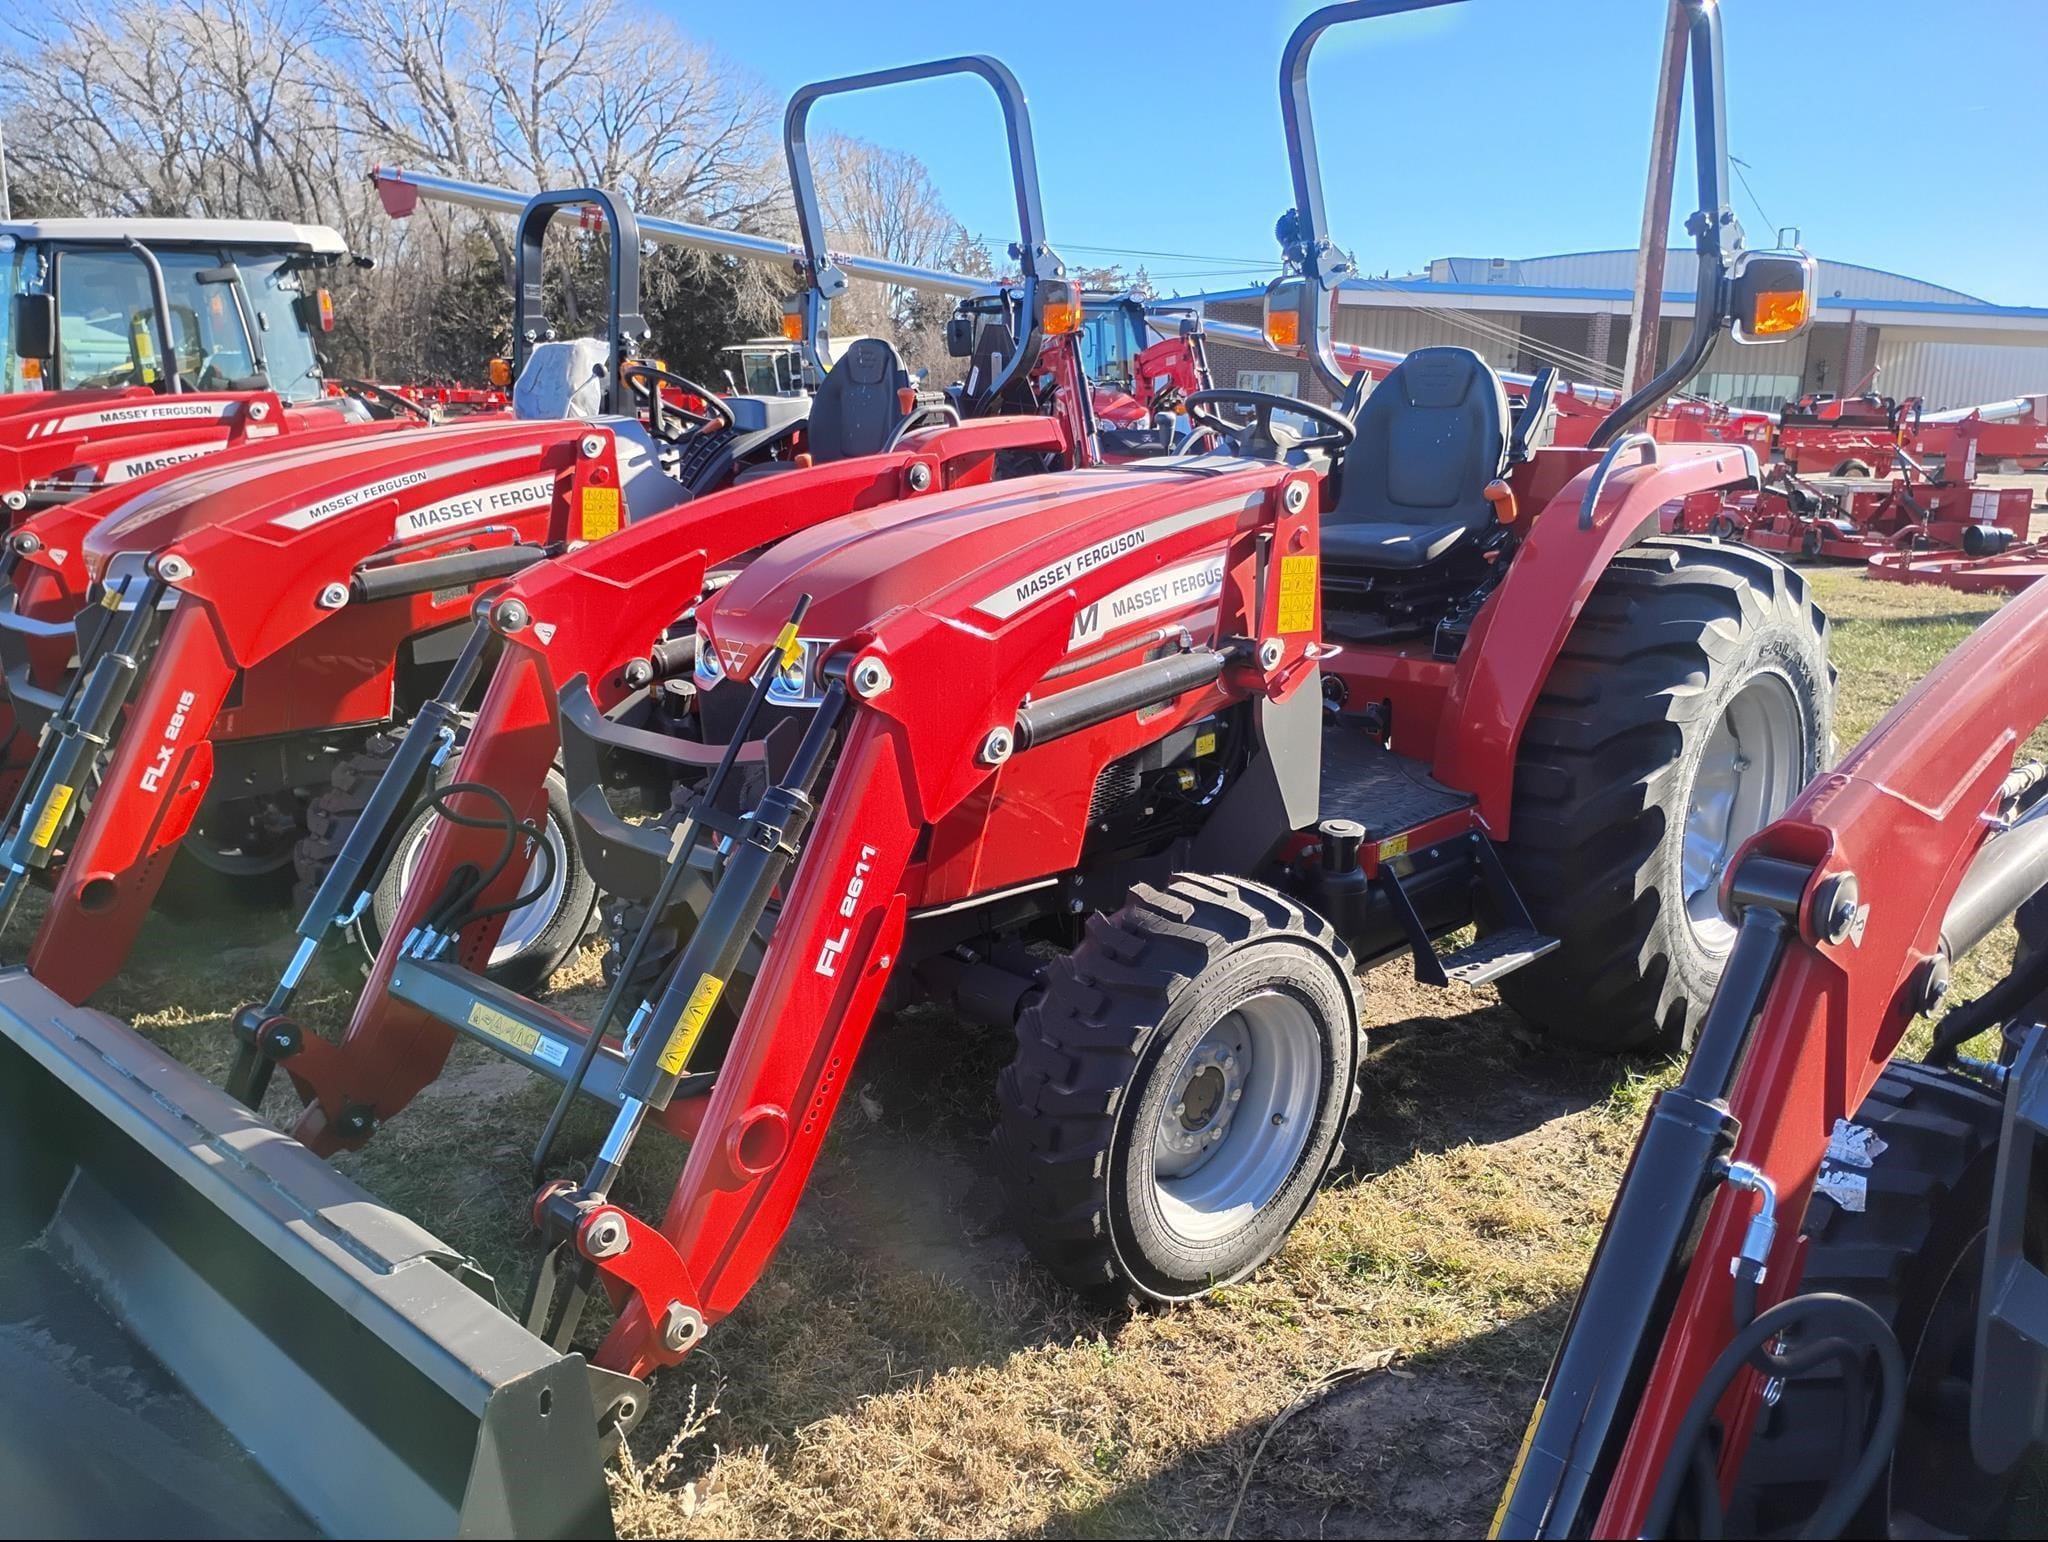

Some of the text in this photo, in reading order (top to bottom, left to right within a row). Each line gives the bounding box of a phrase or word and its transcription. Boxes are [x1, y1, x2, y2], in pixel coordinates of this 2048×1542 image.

[100, 406, 212, 423] MASSEY FERGUSON
[309, 471, 427, 519] MASSEY FERGUSON
[409, 498, 483, 529] MASSEY
[1016, 530, 1146, 602] MASSEY FERGUSON
[1112, 584, 1168, 618] MASSEY
[164, 690, 195, 741] 2815
[815, 845, 876, 978] FL 2611
